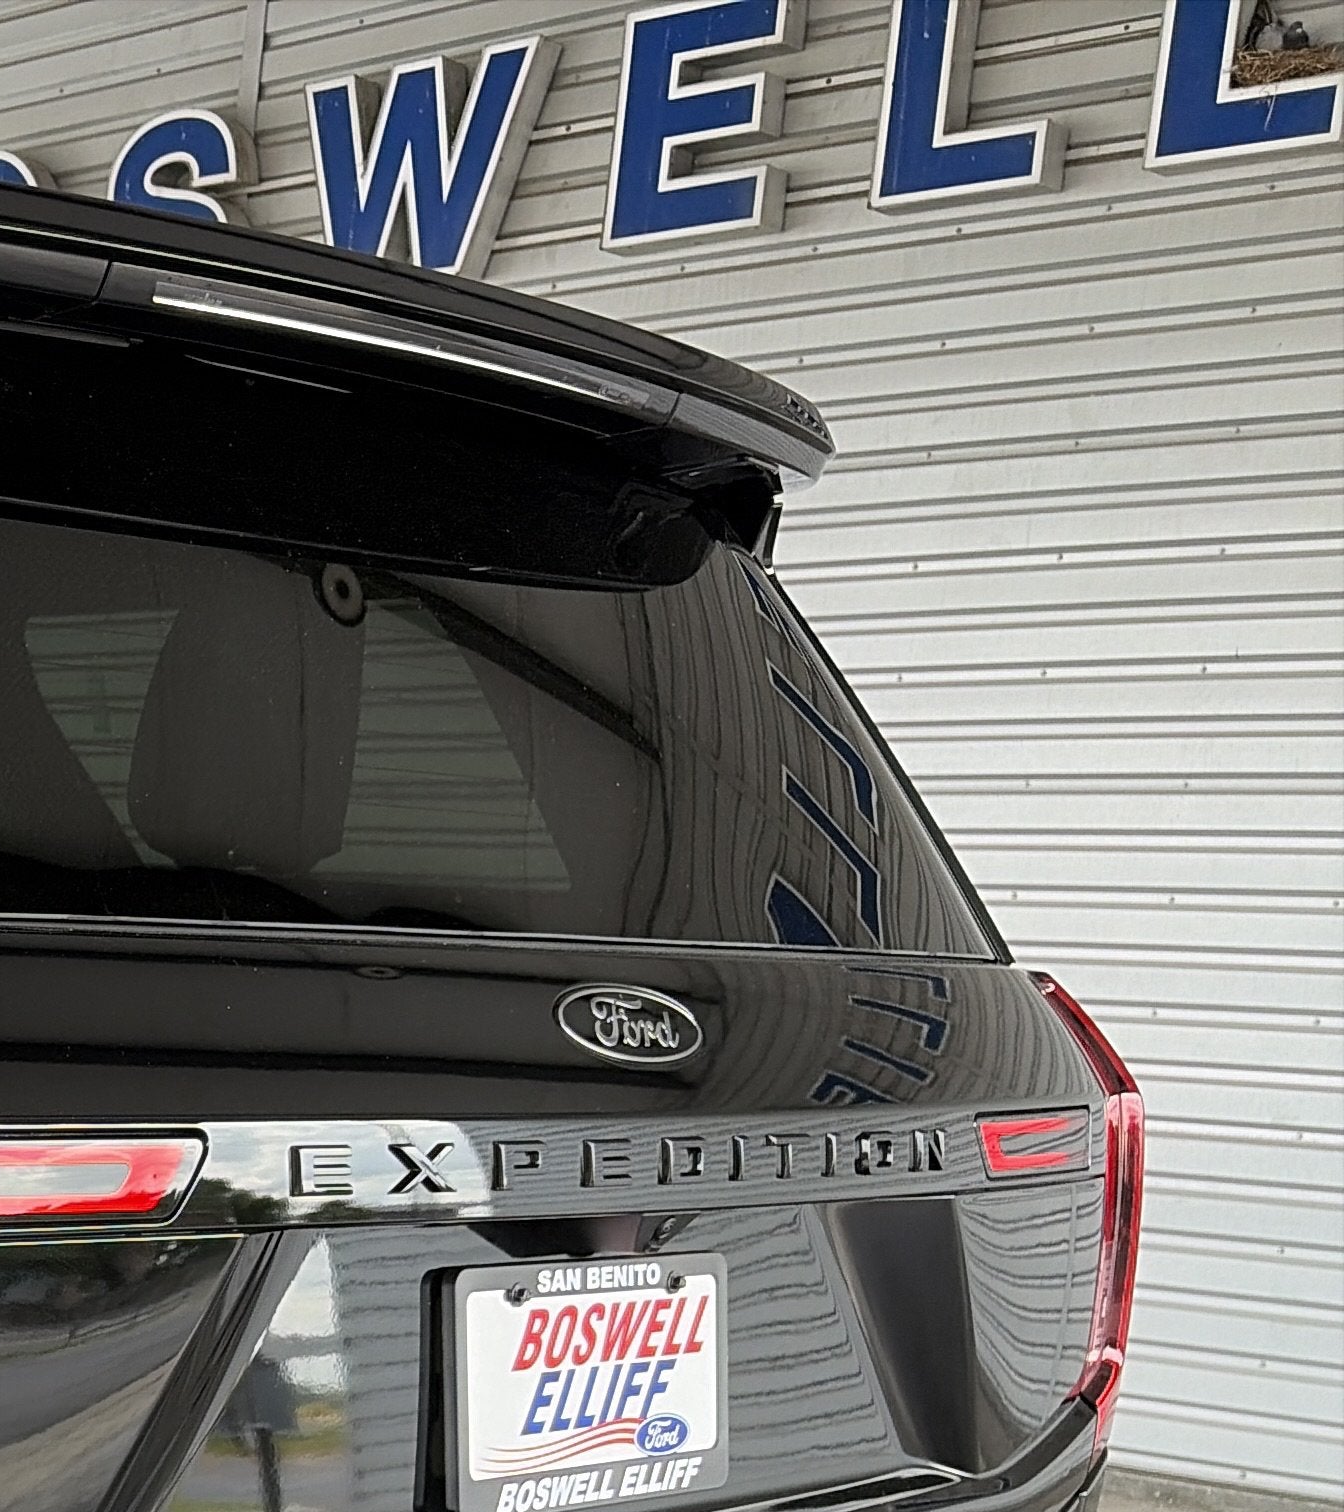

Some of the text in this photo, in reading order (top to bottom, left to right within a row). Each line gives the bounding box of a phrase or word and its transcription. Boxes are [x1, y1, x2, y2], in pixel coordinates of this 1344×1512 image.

[590, 994, 680, 1049] Ford
[288, 1129, 947, 1198] EXPEDITION
[536, 1262, 661, 1293] SAN BENITO
[511, 1295, 710, 1372] BOSWELL
[520, 1358, 677, 1437] ELLIFF
[644, 1420, 680, 1450] Ford
[618, 1456, 702, 1498] ELLIFF
